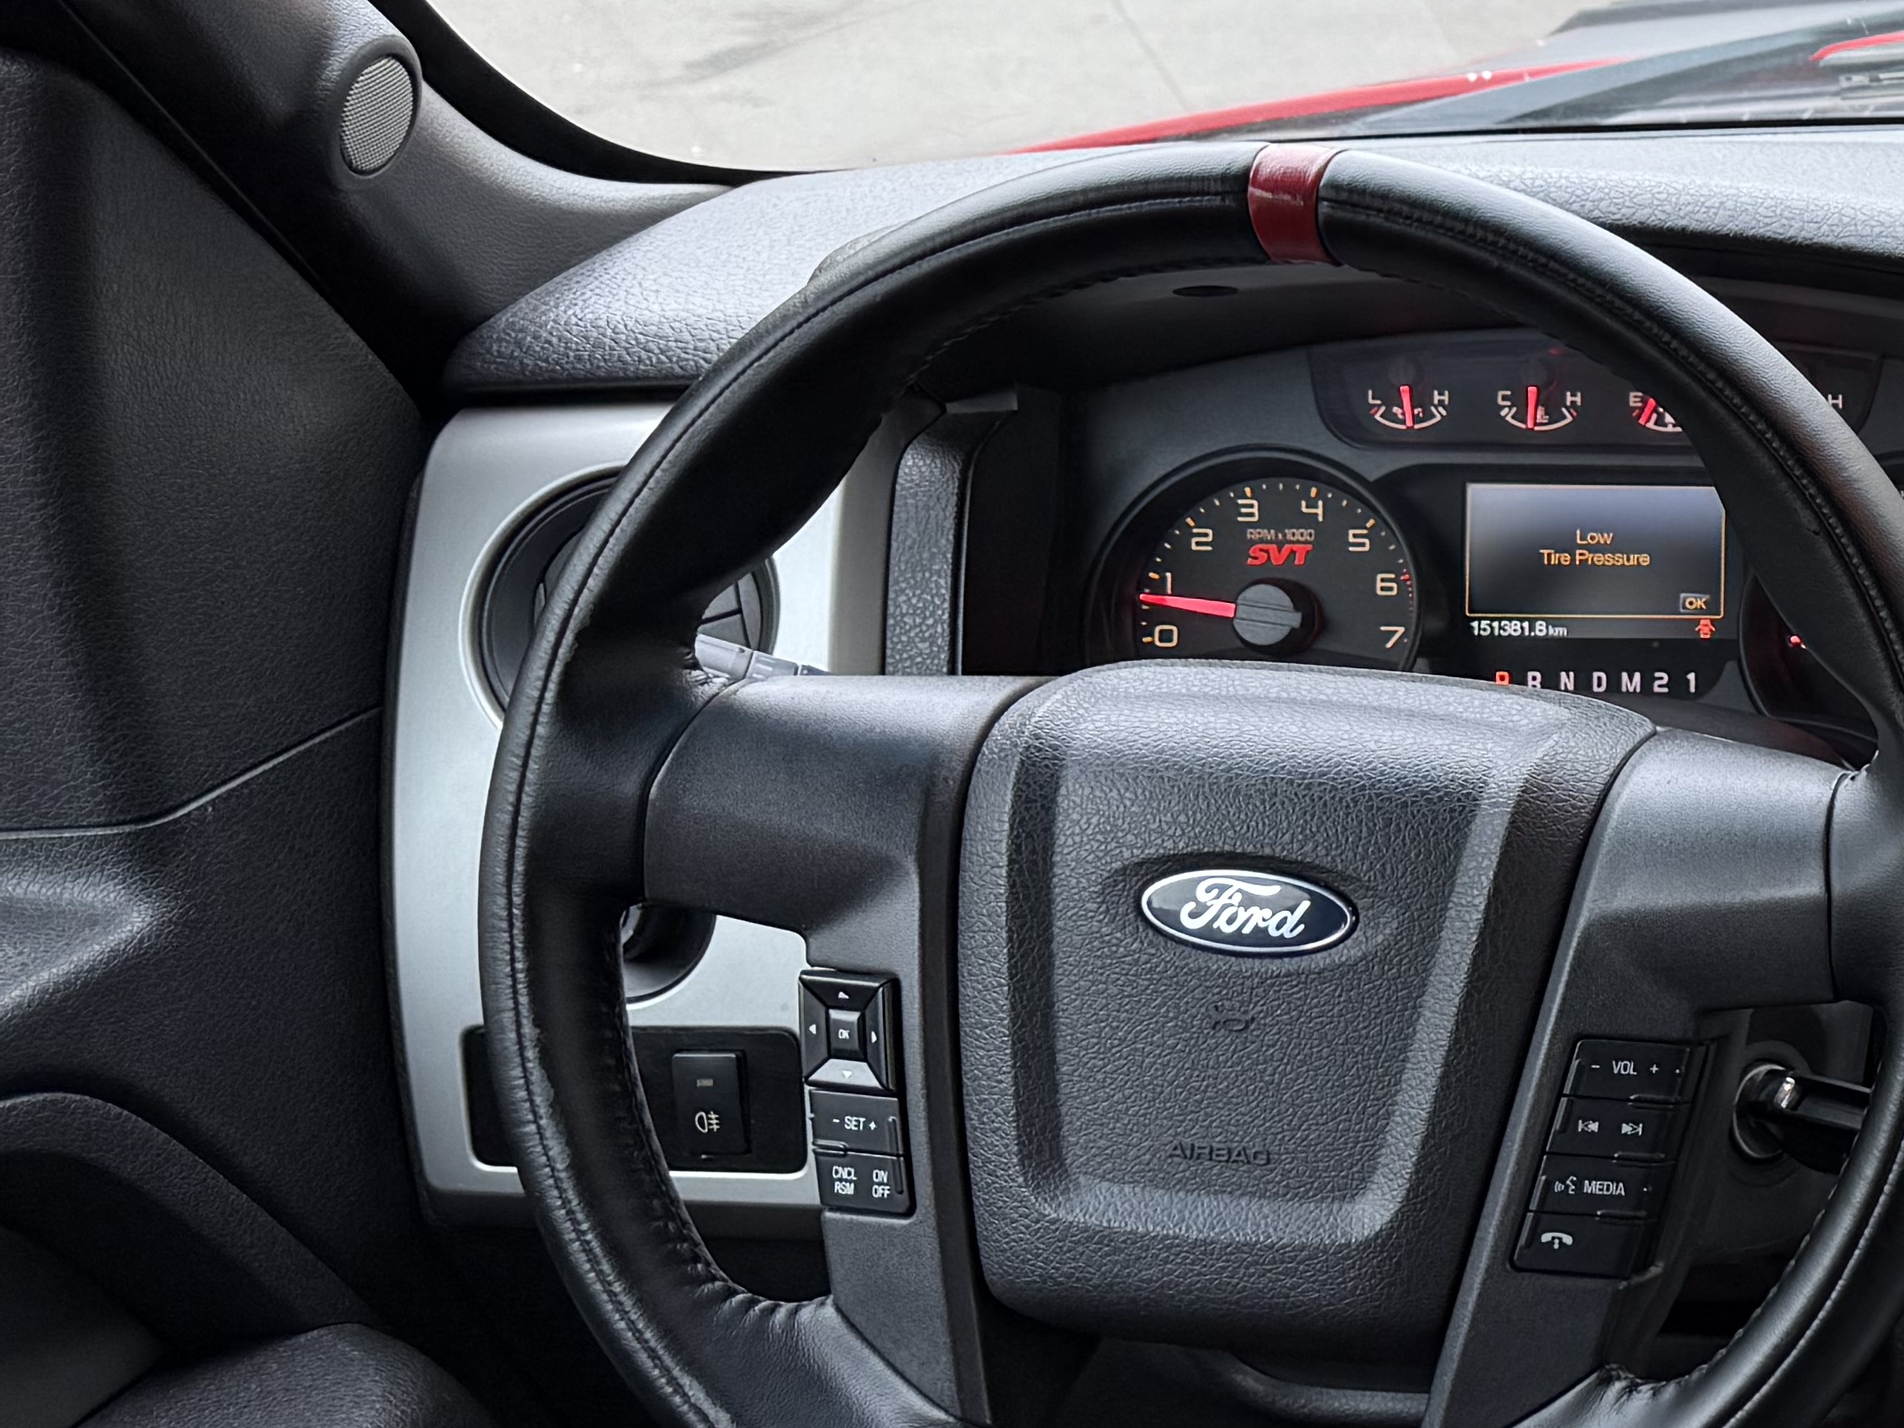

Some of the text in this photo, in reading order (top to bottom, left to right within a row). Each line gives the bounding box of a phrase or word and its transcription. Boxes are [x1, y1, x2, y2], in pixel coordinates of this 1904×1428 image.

[1369, 391, 1381, 404] L
[1433, 392, 1449, 406] H
[1497, 391, 1511, 405] C
[1566, 392, 1581, 406] H
[1629, 392, 1642, 406] E
[1828, 394, 1843, 409] H
[1237, 499, 1258, 521] 3
[1301, 500, 1323, 521] 4
[1191, 528, 1213, 551] 2
[1247, 529, 1275, 540] RPM
[1285, 529, 1315, 540] 1000
[1348, 529, 1370, 551] 5
[1576, 529, 1613, 545] Low
[1247, 544, 1313, 565] SVT
[1540, 549, 1650, 567] Tire Pressure
[1164, 572, 1172, 594] 1
[1376, 574, 1398, 595] 6
[1685, 597, 1707, 610] OK
[1154, 625, 1178, 647] 0
[1380, 626, 1405, 648] 7
[1527, 672, 1541, 689] R
[1560, 672, 1574, 692] N
[1592, 673, 1607, 693] D
[1621, 673, 1641, 693] M
[1653, 673, 1669, 693] 2
[1686, 673, 1696, 693] 1
[1180, 877, 1311, 939] Ford
[838, 1029, 850, 1040] OK
[1612, 1060, 1637, 1075] VOL
[844, 1116, 866, 1131] SET
[832, 1165, 888, 1183] CNCL ON
[834, 1182, 891, 1199] RSM OFF
[1584, 1180, 1625, 1196] MEDIA
